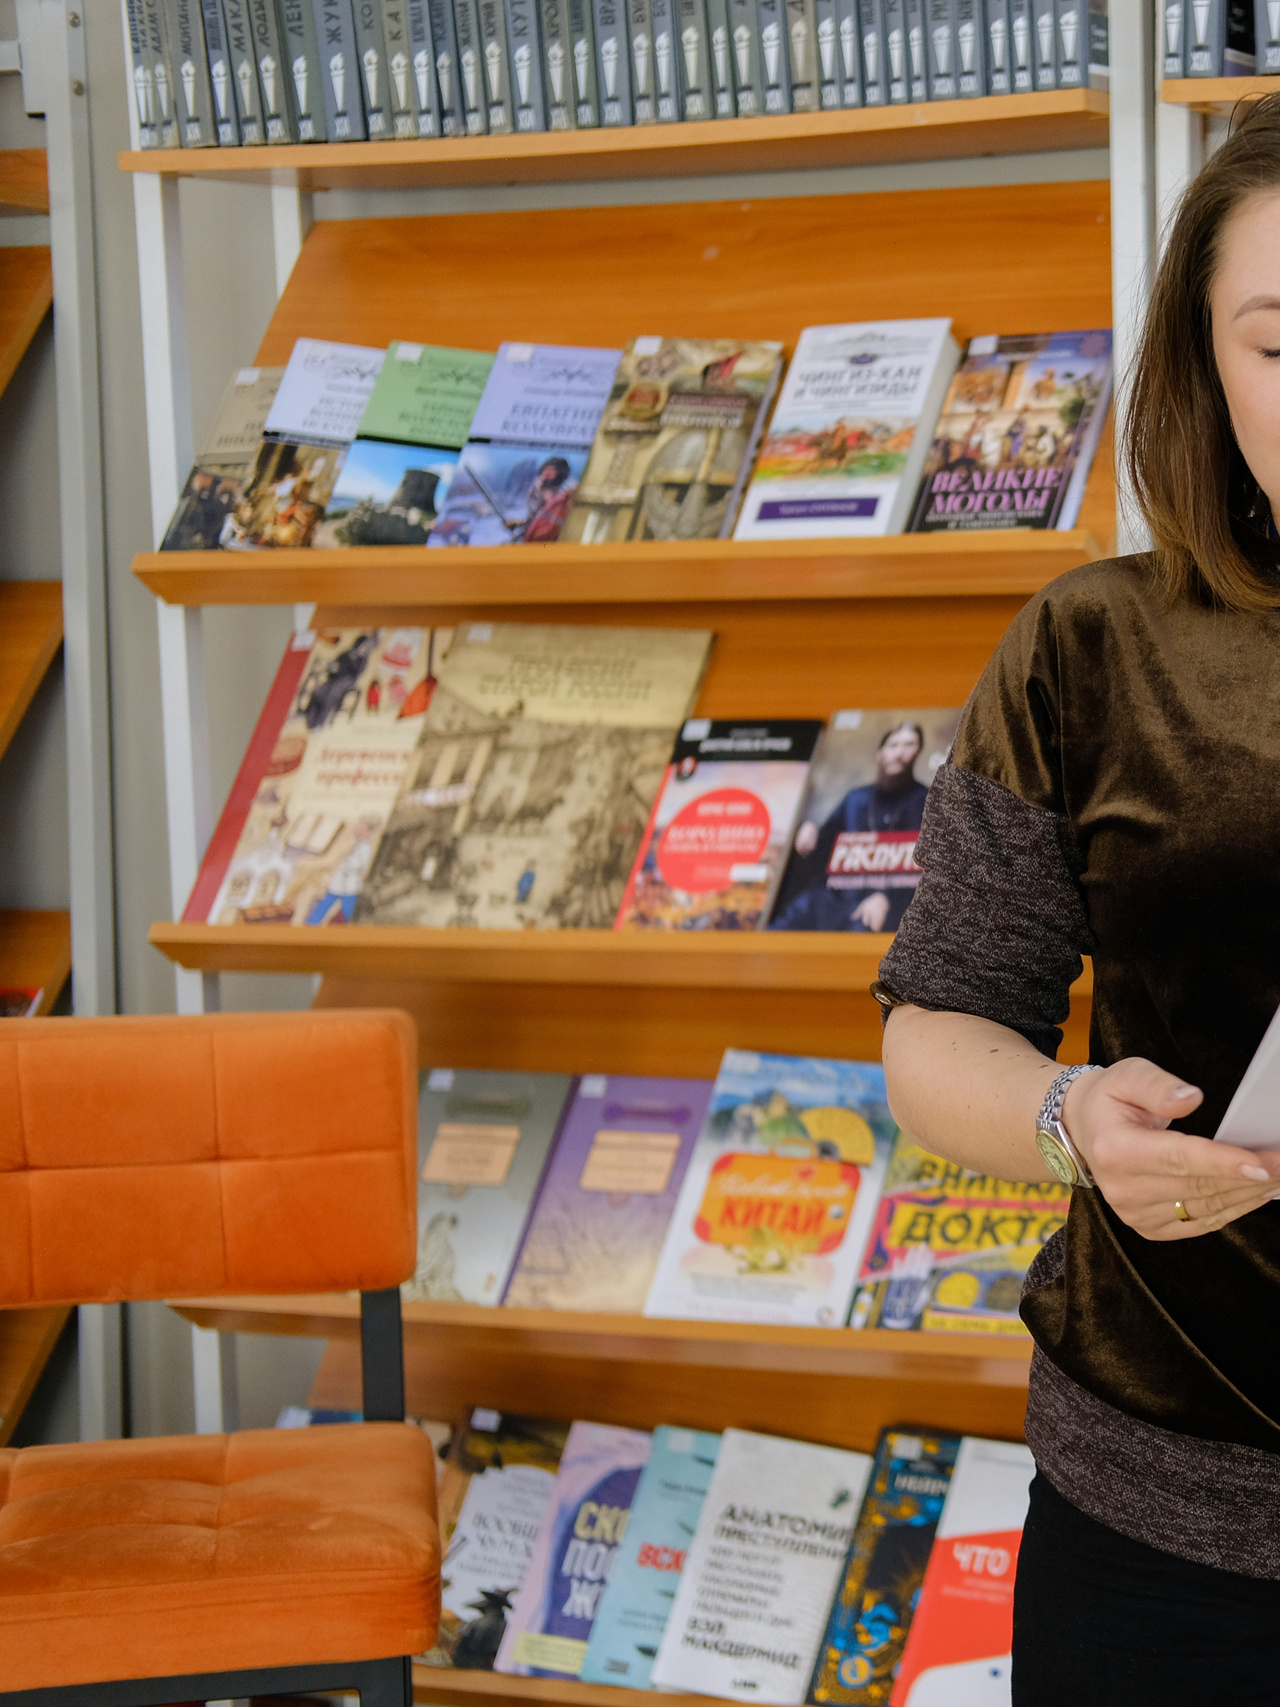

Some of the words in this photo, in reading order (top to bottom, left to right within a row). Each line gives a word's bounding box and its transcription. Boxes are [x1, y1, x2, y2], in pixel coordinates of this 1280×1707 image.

[932, 467, 1063, 493] ВЕЛИКИЕ
[932, 490, 1050, 513] МОГОЛЫ
[953, 1543, 1011, 1577] ЧТО
